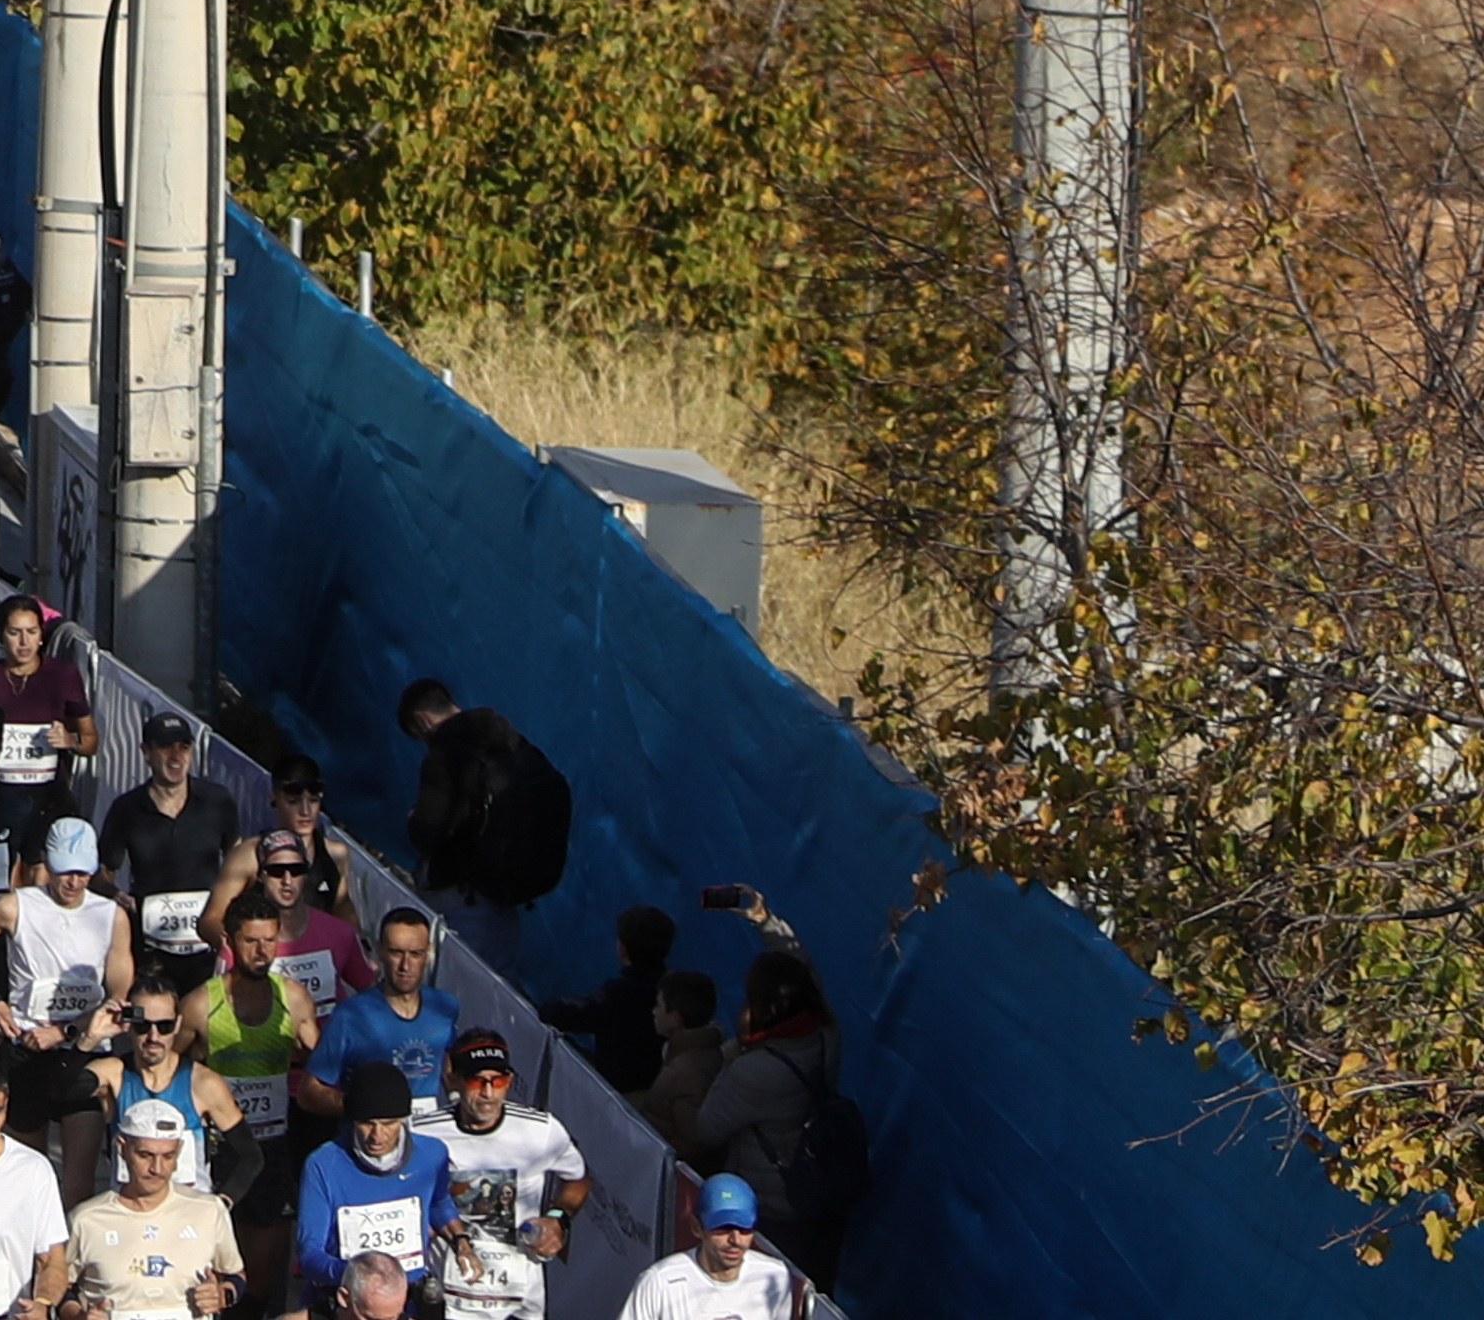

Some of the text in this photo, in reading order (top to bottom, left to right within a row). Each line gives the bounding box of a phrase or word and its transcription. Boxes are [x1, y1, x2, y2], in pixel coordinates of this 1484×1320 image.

[159, 916, 198, 931] 2318
[46, 997, 88, 1011] 2330
[359, 1228, 405, 1248] 2336
[488, 1270, 508, 1283] 14
